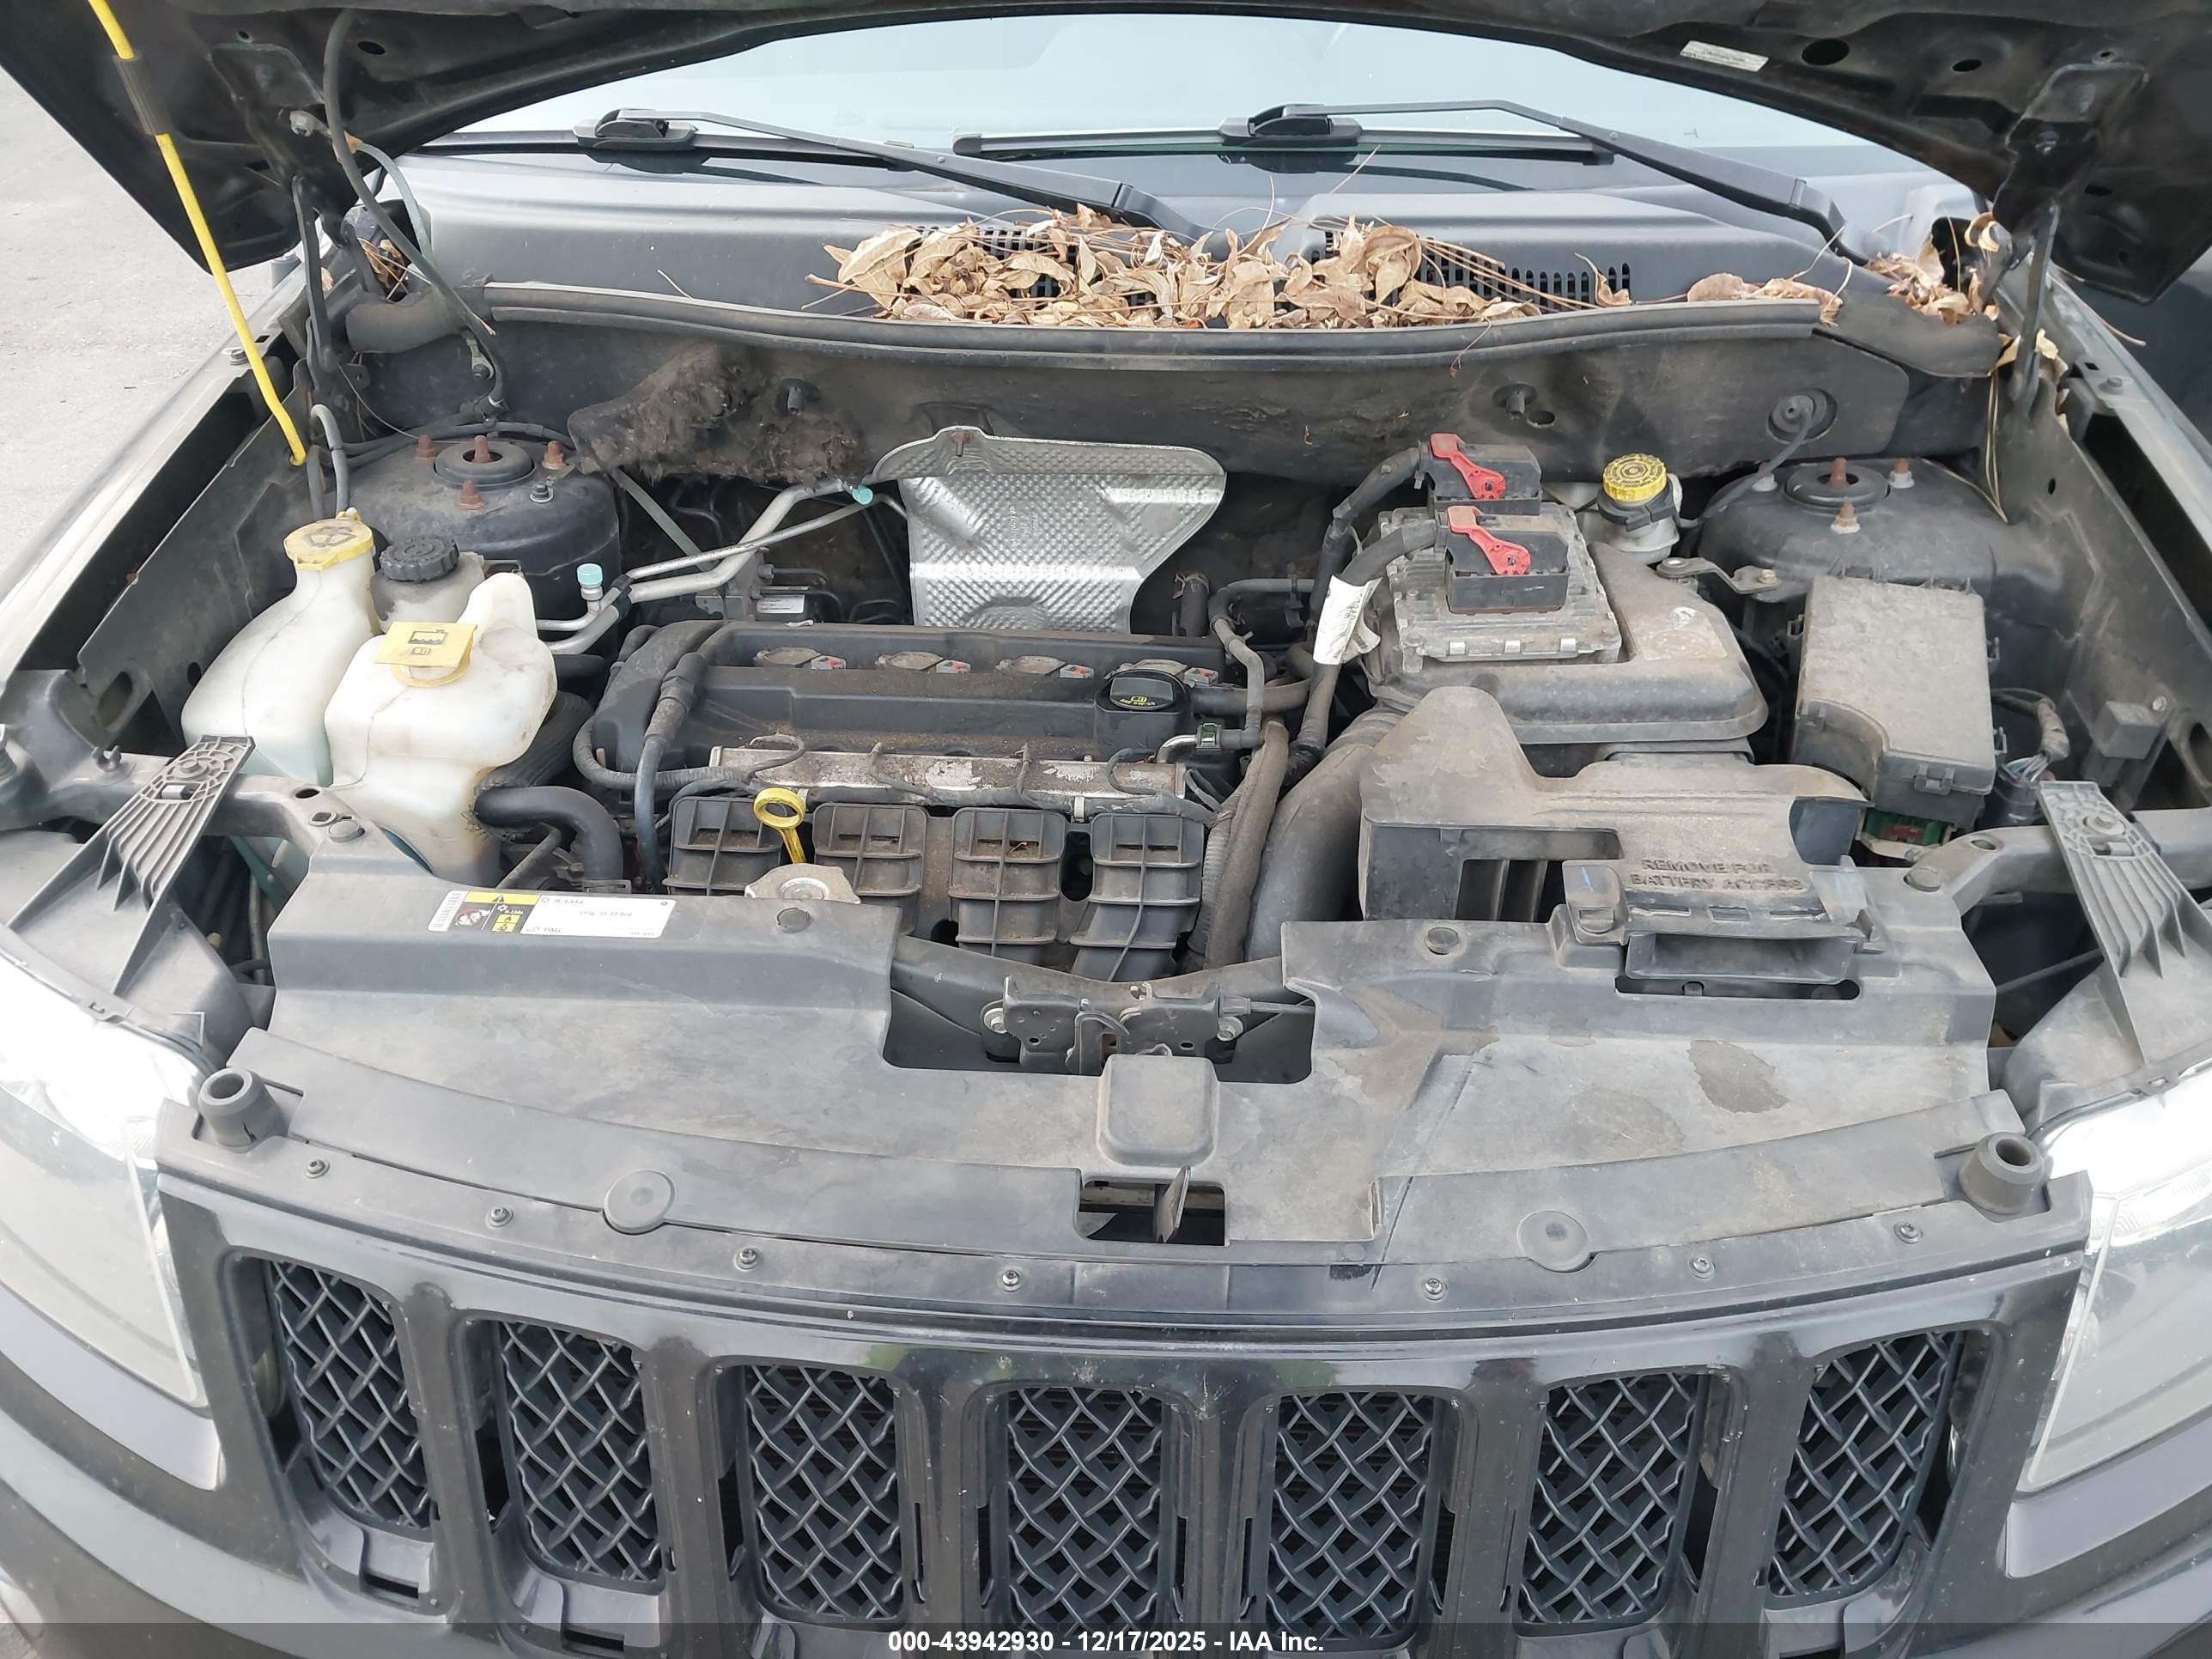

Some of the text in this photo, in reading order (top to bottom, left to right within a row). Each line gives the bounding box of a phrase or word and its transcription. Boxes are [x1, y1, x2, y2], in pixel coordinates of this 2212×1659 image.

[1642, 859, 1773, 874] REMOVE FOR
[1631, 874, 1805, 890] BATTERY ACCESS
